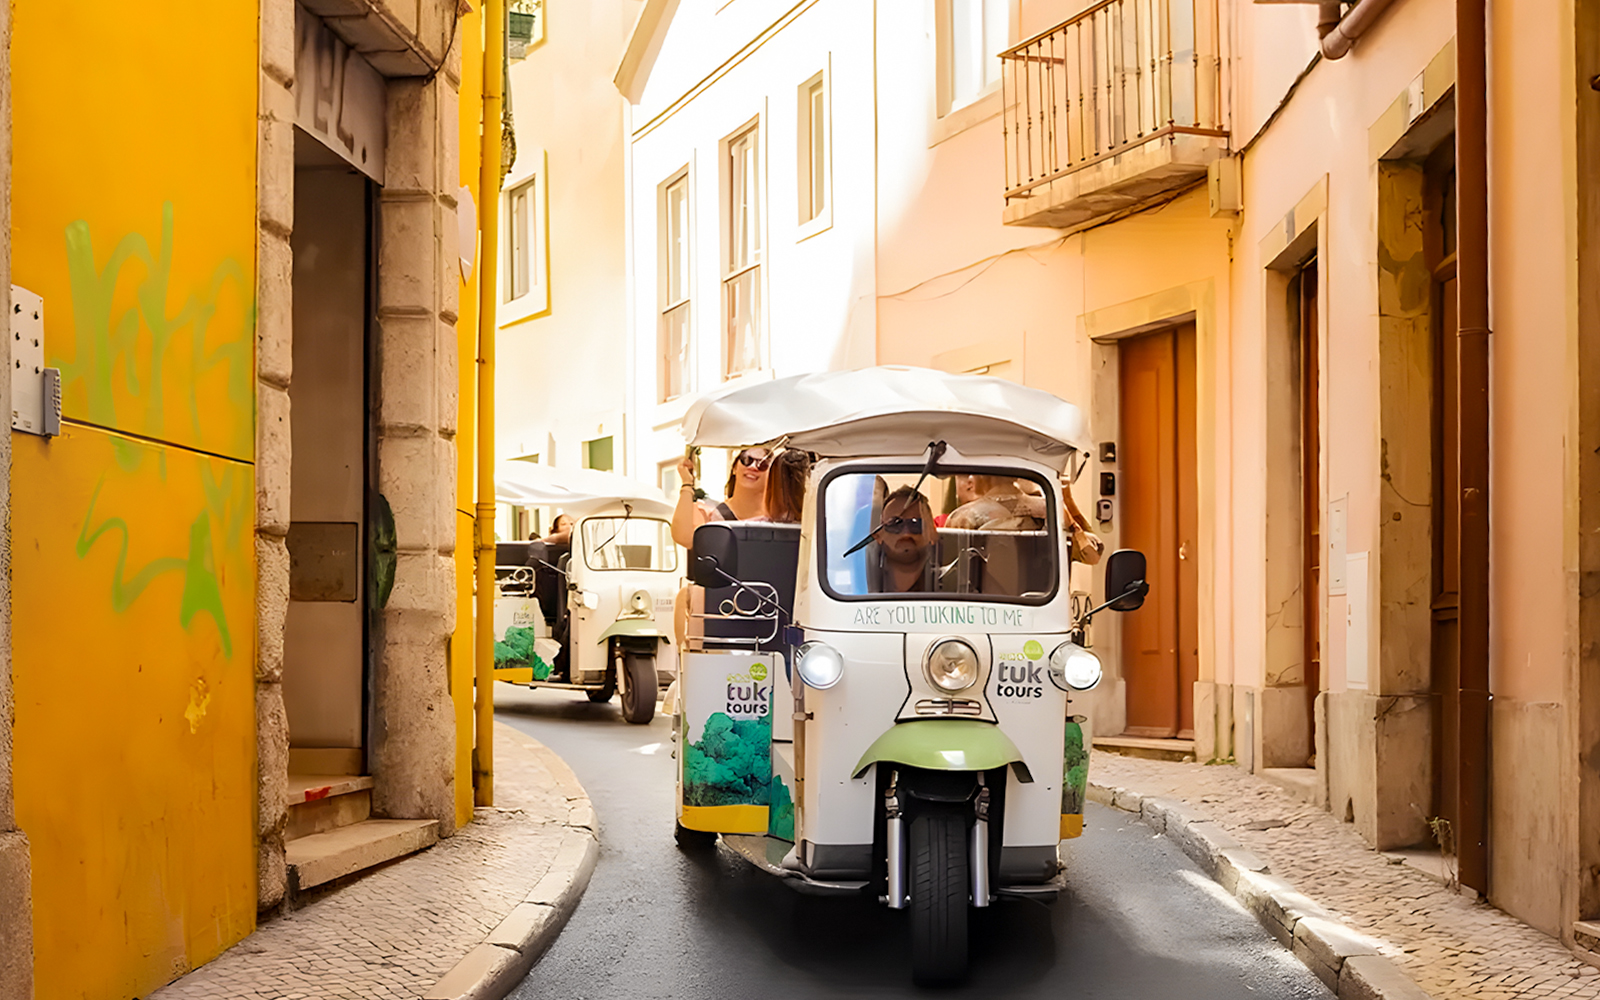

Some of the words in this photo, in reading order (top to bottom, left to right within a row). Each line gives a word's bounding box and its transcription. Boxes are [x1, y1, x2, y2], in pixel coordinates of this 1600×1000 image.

[854, 606, 880, 625] ARE
[887, 606, 916, 625] YOU
[921, 605, 974, 625] TUKING
[981, 606, 997, 626] TO
[1004, 609, 1022, 627] ME
[998, 661, 1043, 684] tuk
[727, 682, 767, 702] tuk
[997, 683, 1043, 698] tours
[726, 702, 768, 714] tours
